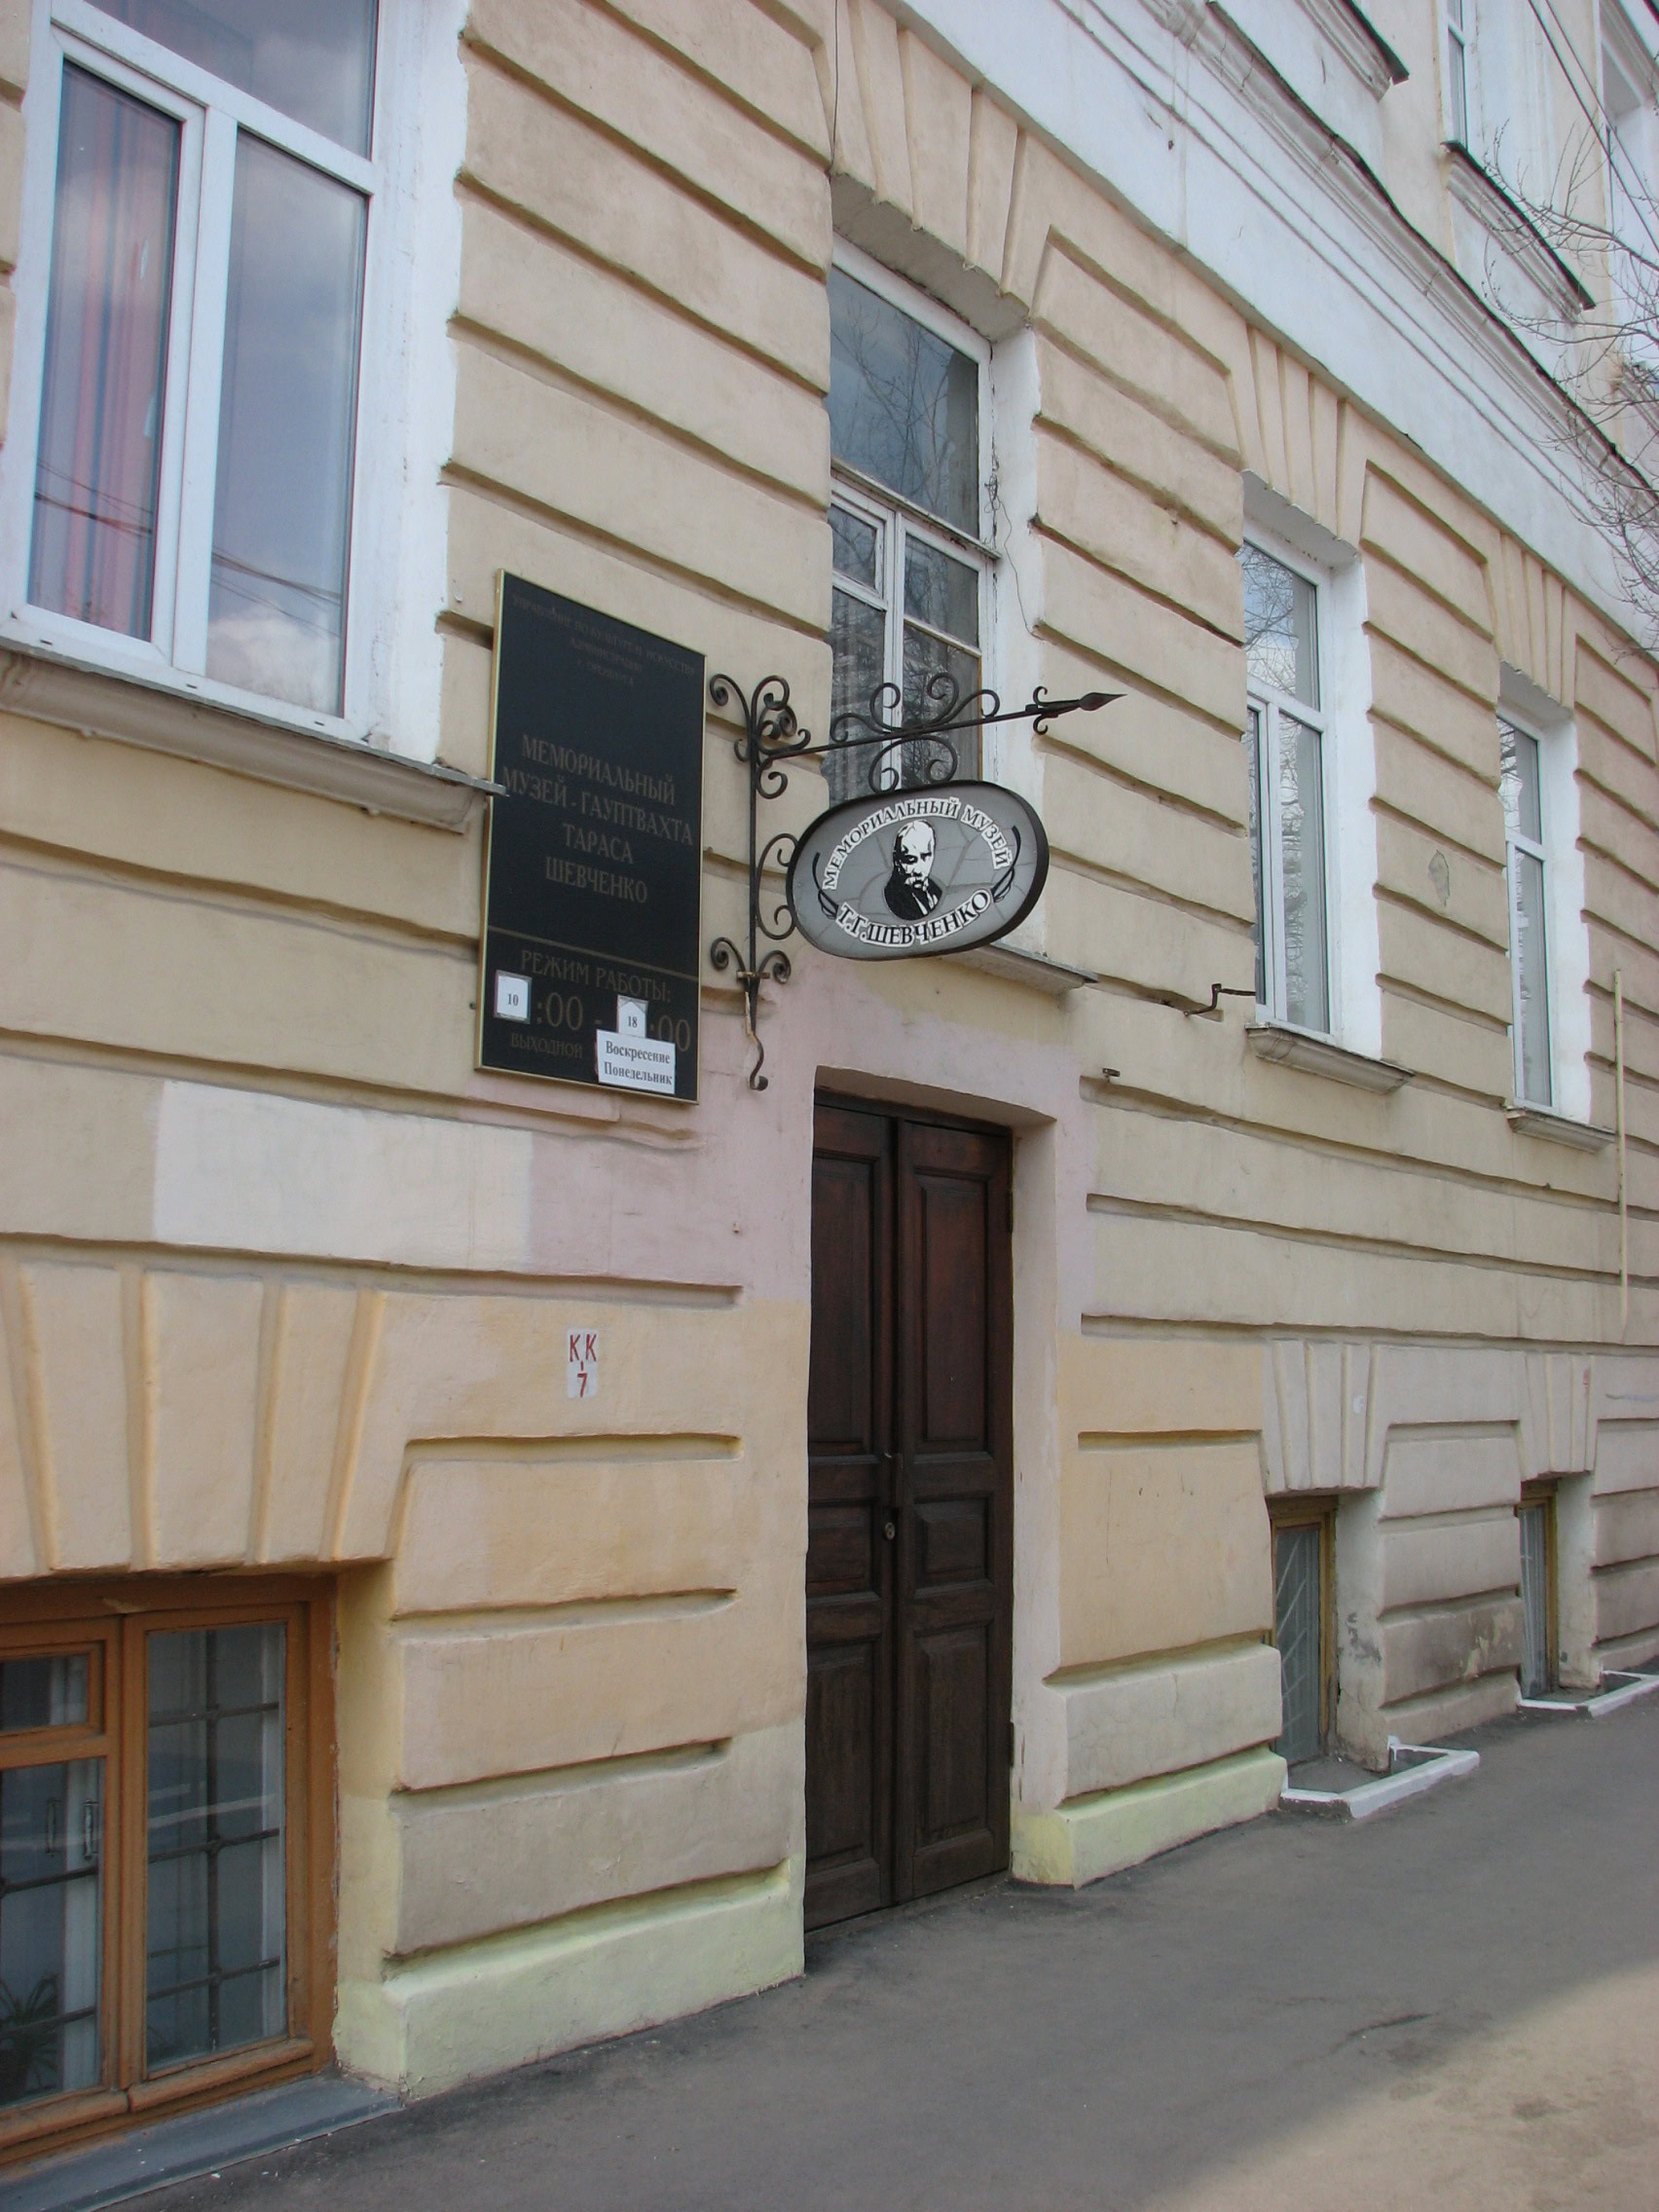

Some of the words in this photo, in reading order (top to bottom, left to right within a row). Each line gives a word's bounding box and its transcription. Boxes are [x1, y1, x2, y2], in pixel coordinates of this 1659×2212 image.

[522, 734, 676, 806] МЕМОРИАЛЬНЫЙ
[502, 766, 568, 809] МУЗЕЙ
[580, 792, 693, 846] ГАУПТВАХТА
[563, 822, 634, 865] ТАРАСА
[824, 797, 960, 890] МЕМОРИАЛЬНЫЙ
[963, 807, 1012, 868] МУЗЕЙ
[545, 856, 648, 903] ШЕВЧЕНКО
[521, 949, 590, 985] РЕЖИМ
[597, 967, 672, 1004] РАБОТЫ:
[507, 993, 519, 1007] 10
[627, 1015, 638, 1028] 18
[511, 1032, 583, 1059] ВЫХОДНОЙ
[604, 1061, 673, 1086] Понедельник
